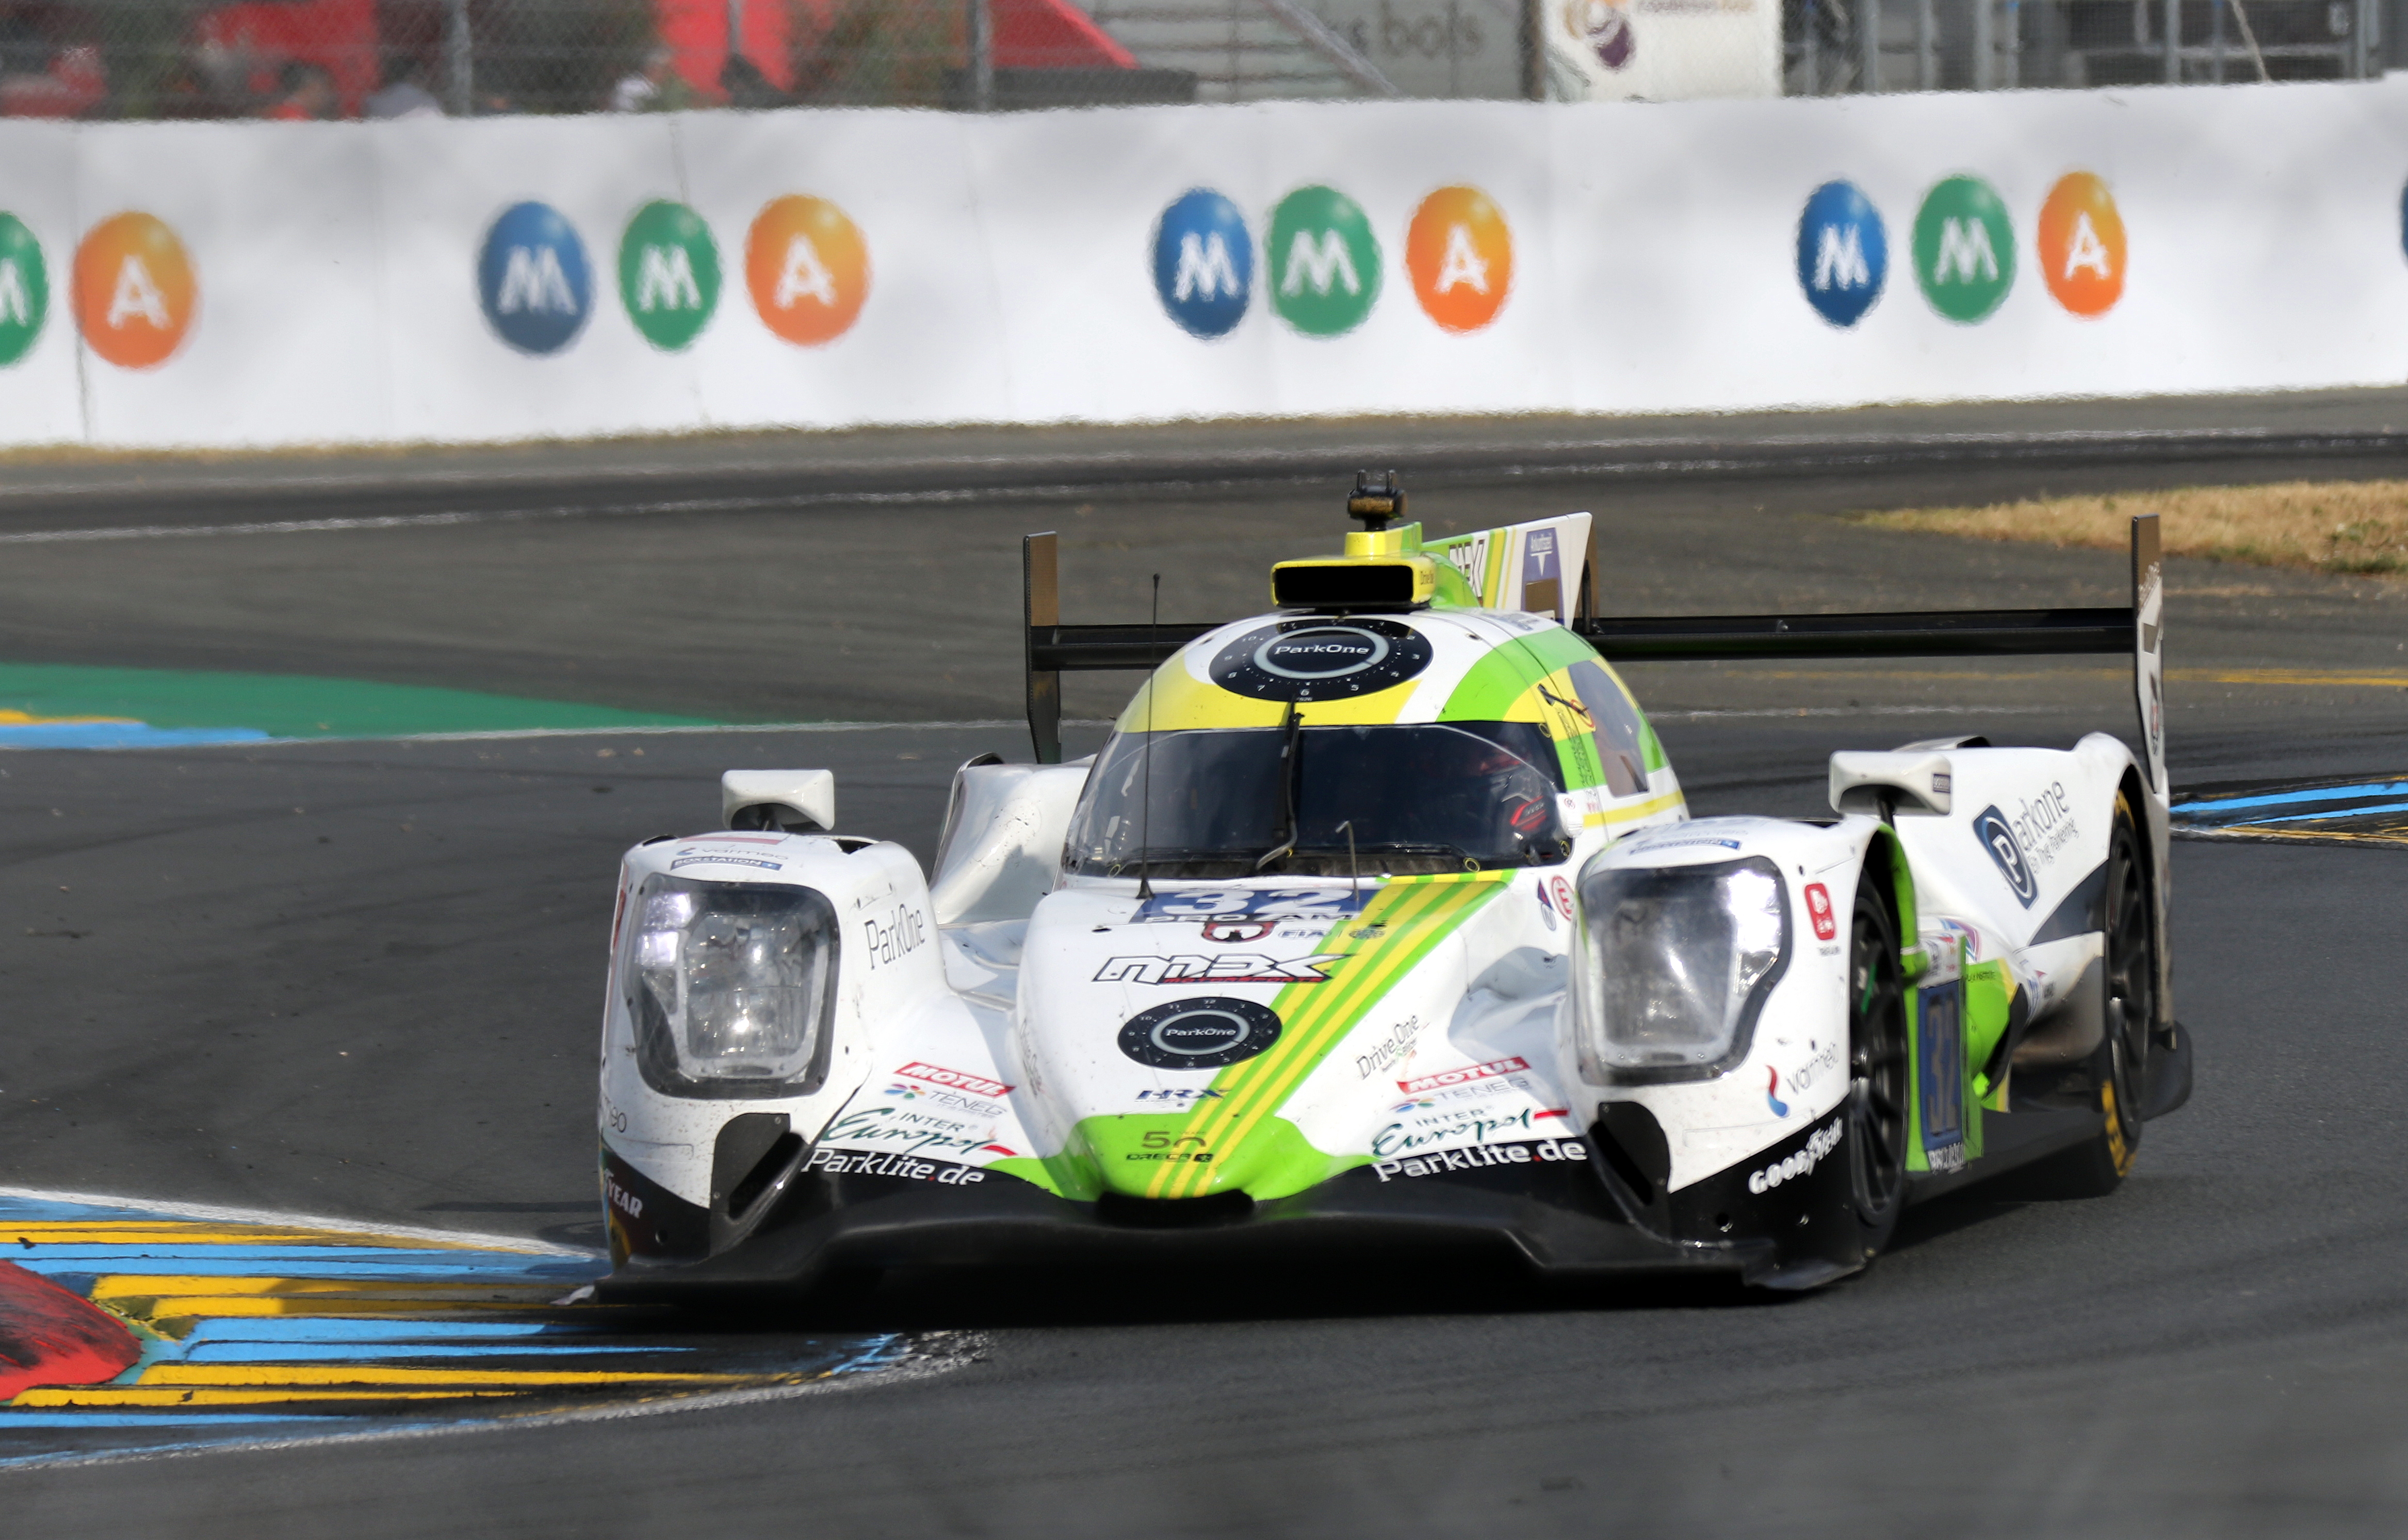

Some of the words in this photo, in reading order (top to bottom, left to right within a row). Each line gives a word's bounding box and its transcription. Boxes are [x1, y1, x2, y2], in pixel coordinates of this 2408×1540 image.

[1274, 644, 1370, 656] ParkOne
[1163, 889, 1353, 915] 32
[864, 904, 925, 970] ParkOne
[1166, 1027, 1236, 1037] ParkOne
[902, 1064, 1006, 1096] MOTUL
[1408, 1058, 1522, 1092] MOTUL
[900, 1112, 965, 1132] INTER
[1415, 1109, 1484, 1126] INTER
[801, 1148, 986, 1186] Parklite.de
[1372, 1138, 1588, 1183] Parklite.de
